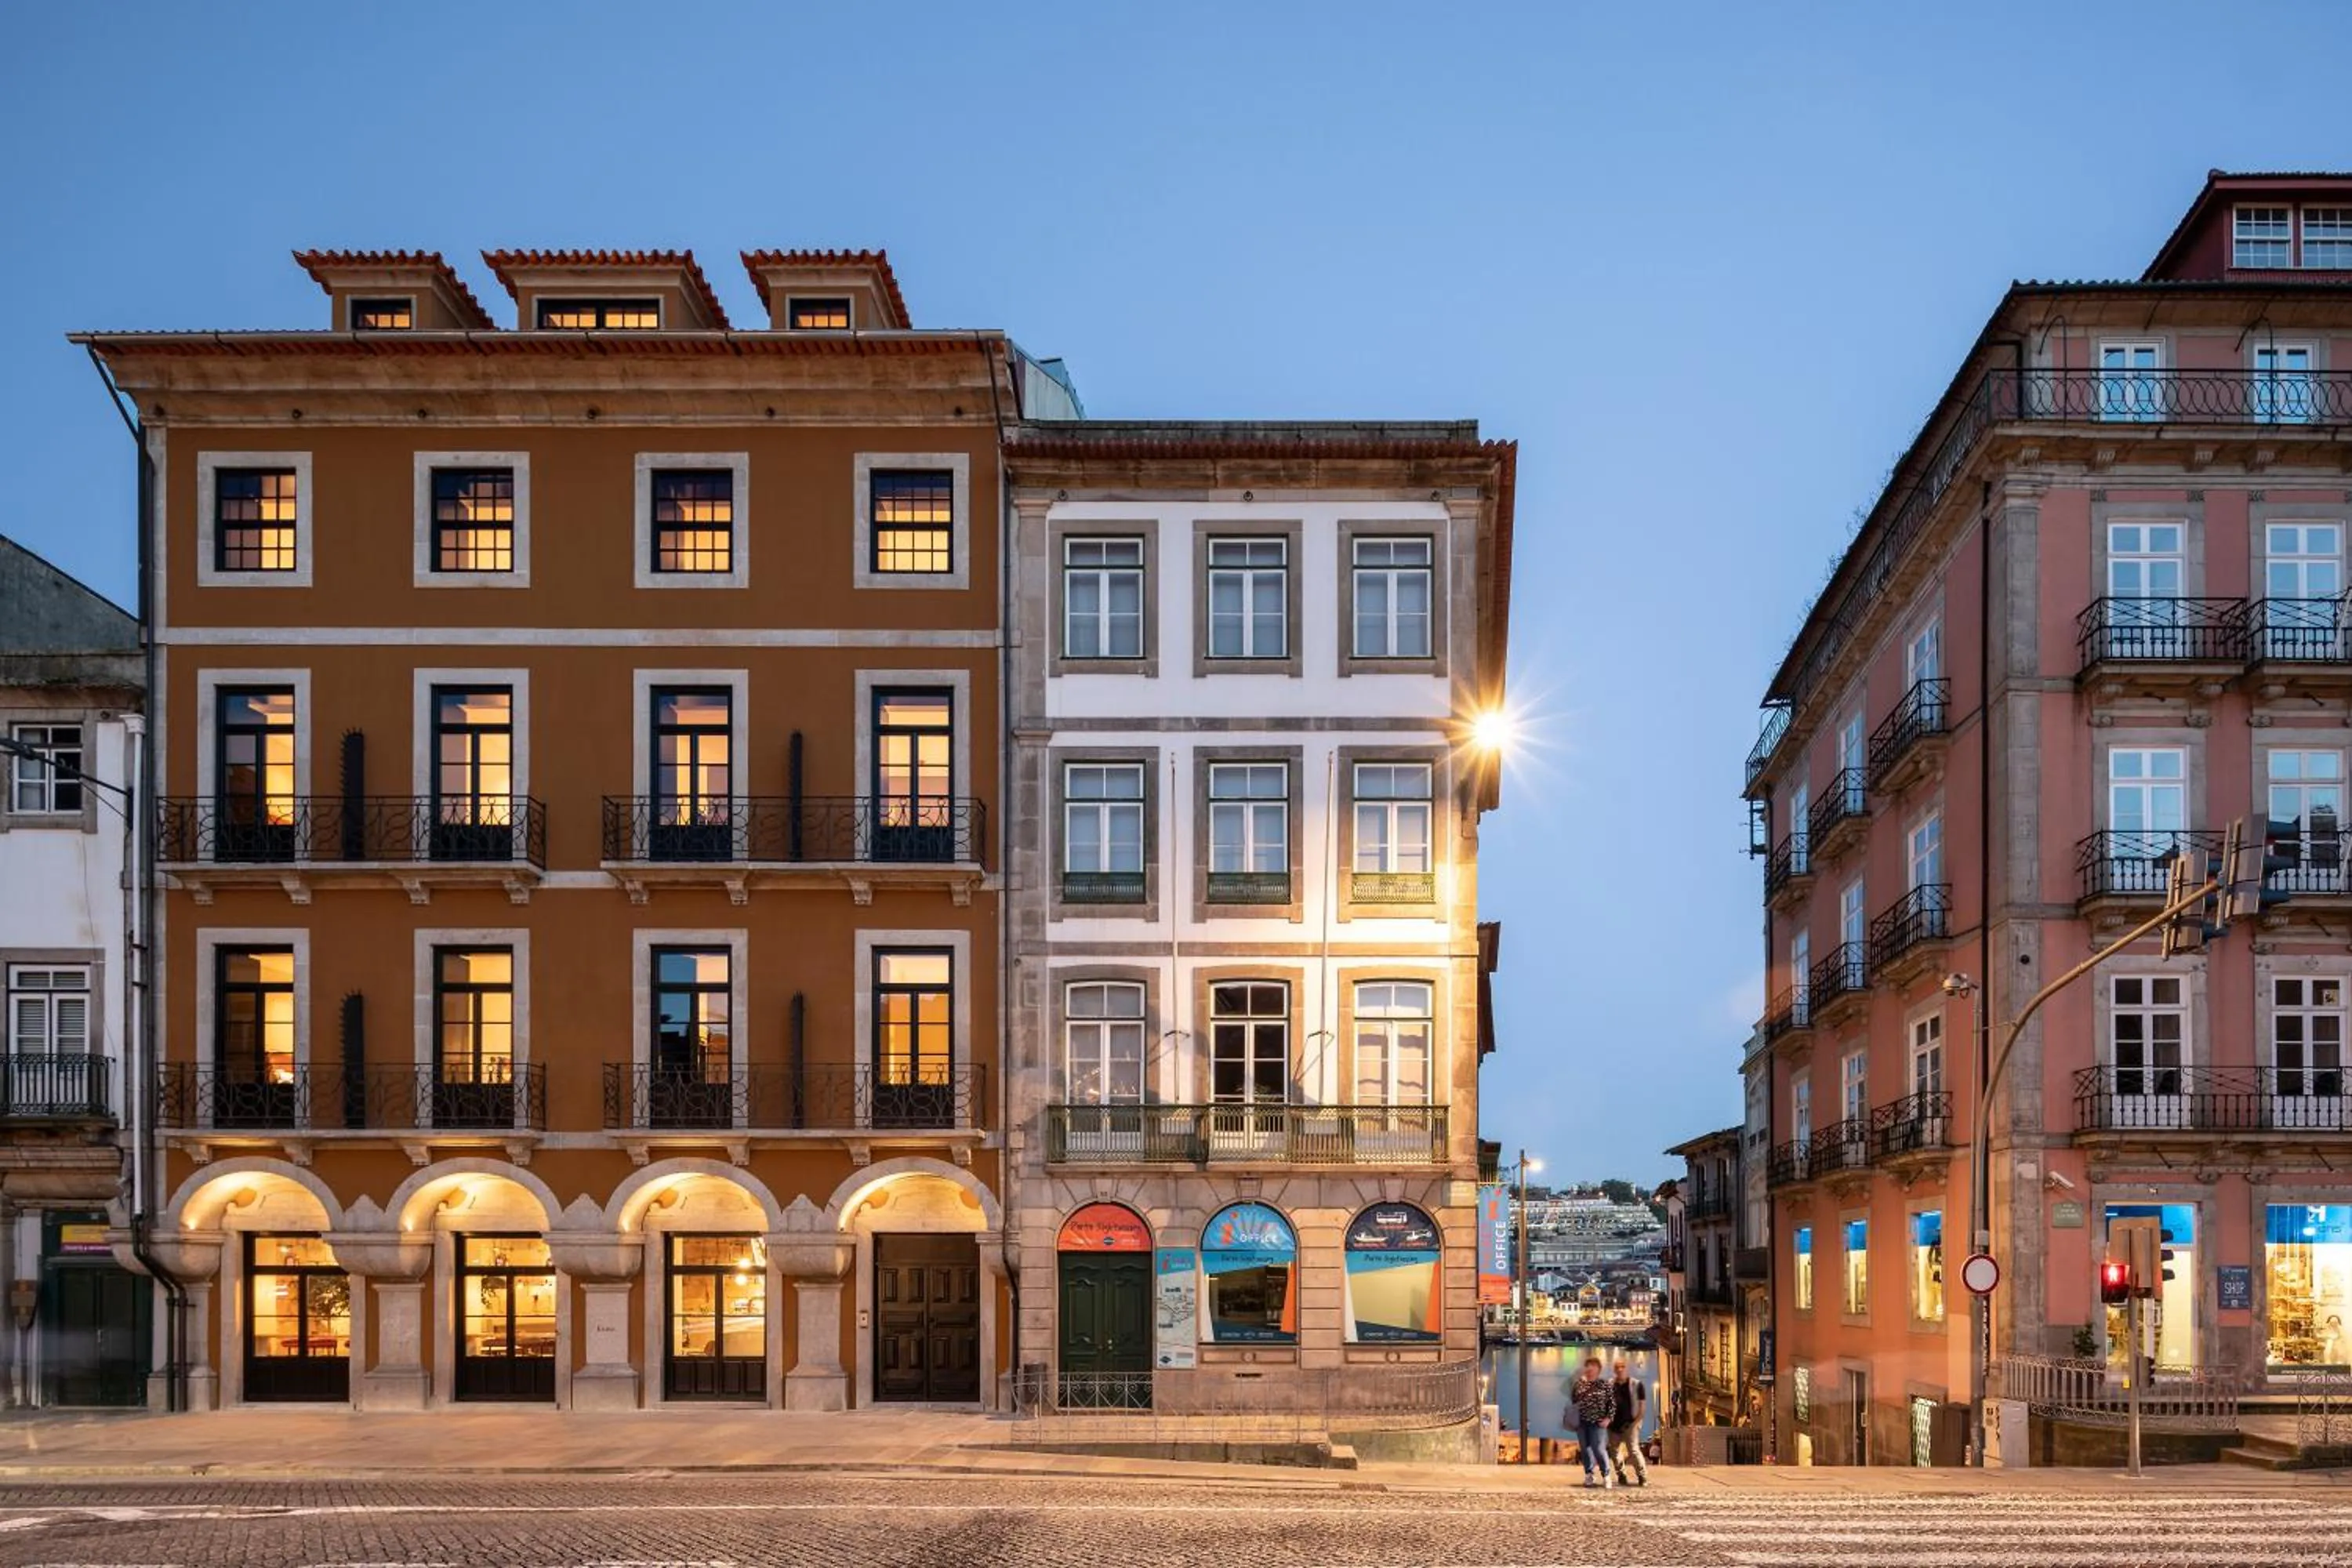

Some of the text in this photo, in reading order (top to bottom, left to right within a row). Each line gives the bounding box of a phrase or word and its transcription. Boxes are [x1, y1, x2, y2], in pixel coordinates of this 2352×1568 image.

[1240, 1232, 1279, 1243] OFFICE
[1495, 1221, 1507, 1270] OFFICE
[2223, 1281, 2246, 1294] SHOP
